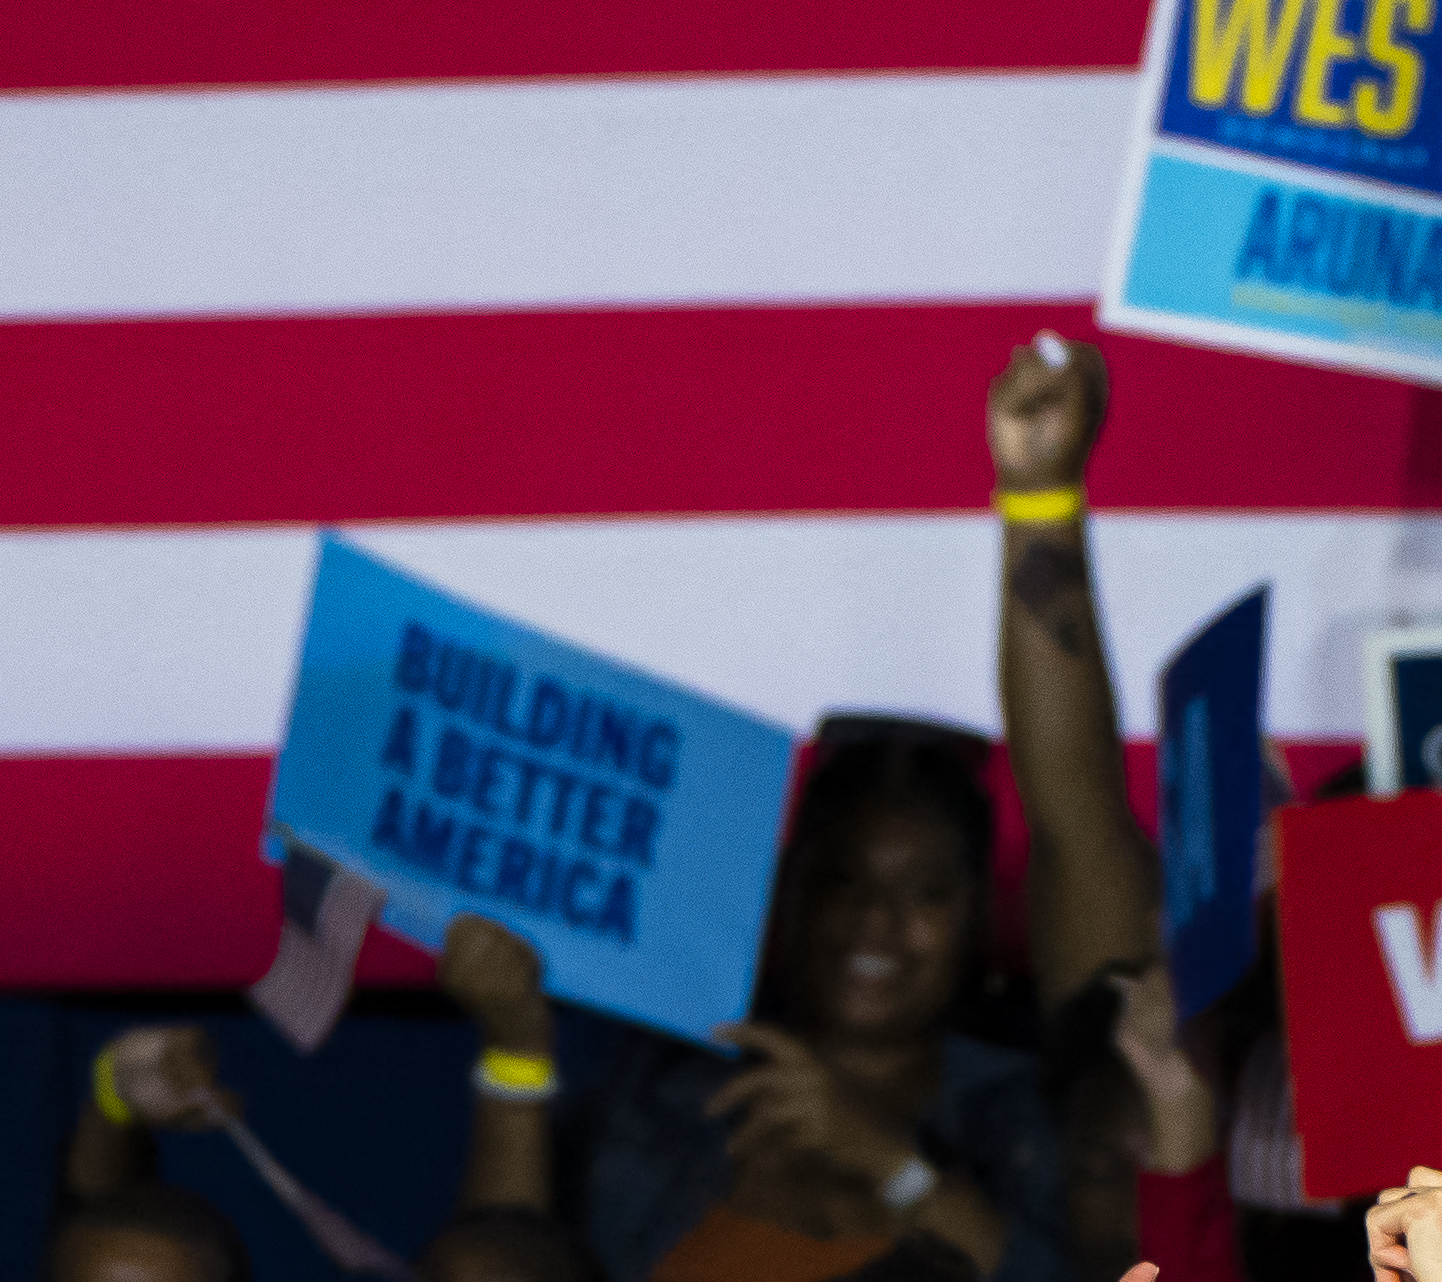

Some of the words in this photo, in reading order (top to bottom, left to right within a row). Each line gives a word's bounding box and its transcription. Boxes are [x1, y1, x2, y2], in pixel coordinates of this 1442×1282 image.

[1188, 0, 1434, 137] WES
[391, 618, 683, 792] BUILDING
[368, 785, 638, 946] AMERICA
[378, 704, 422, 778] A
[431, 723, 664, 872] BETTER
